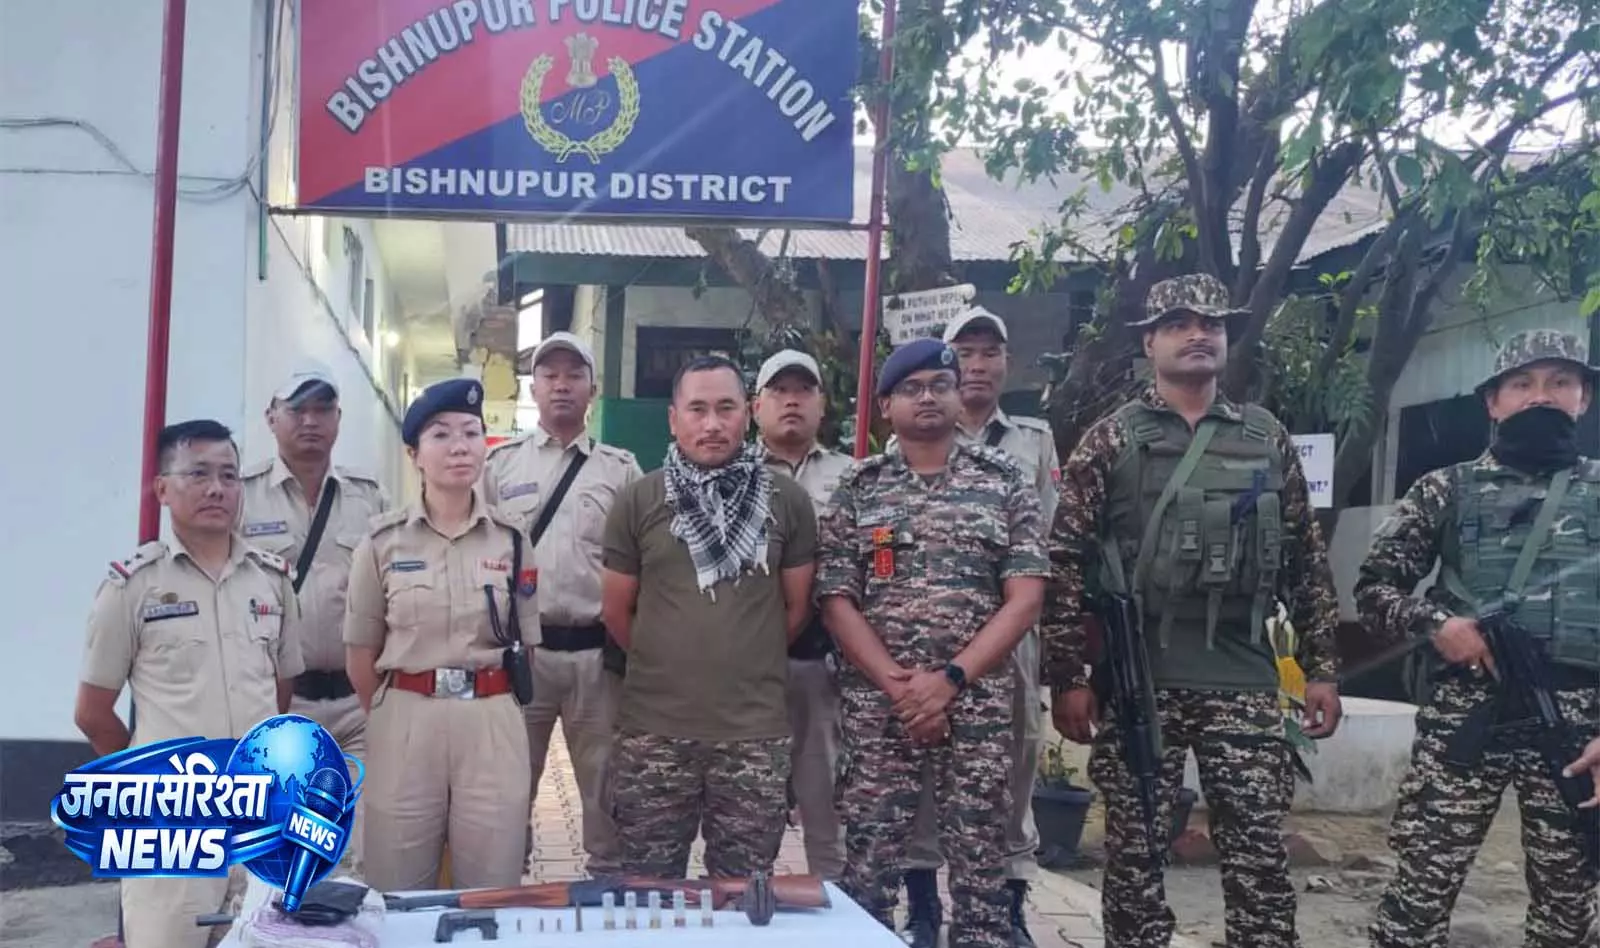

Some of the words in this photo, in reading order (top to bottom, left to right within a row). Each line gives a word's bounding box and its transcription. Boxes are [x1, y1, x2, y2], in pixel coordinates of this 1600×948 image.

[326, 0, 535, 131] BISHNUPUR
[550, 0, 688, 38] POLICE
[693, 10, 836, 142] STATION
[364, 167, 597, 199] BISHNUPUR
[610, 172, 792, 203] DISTRICT
